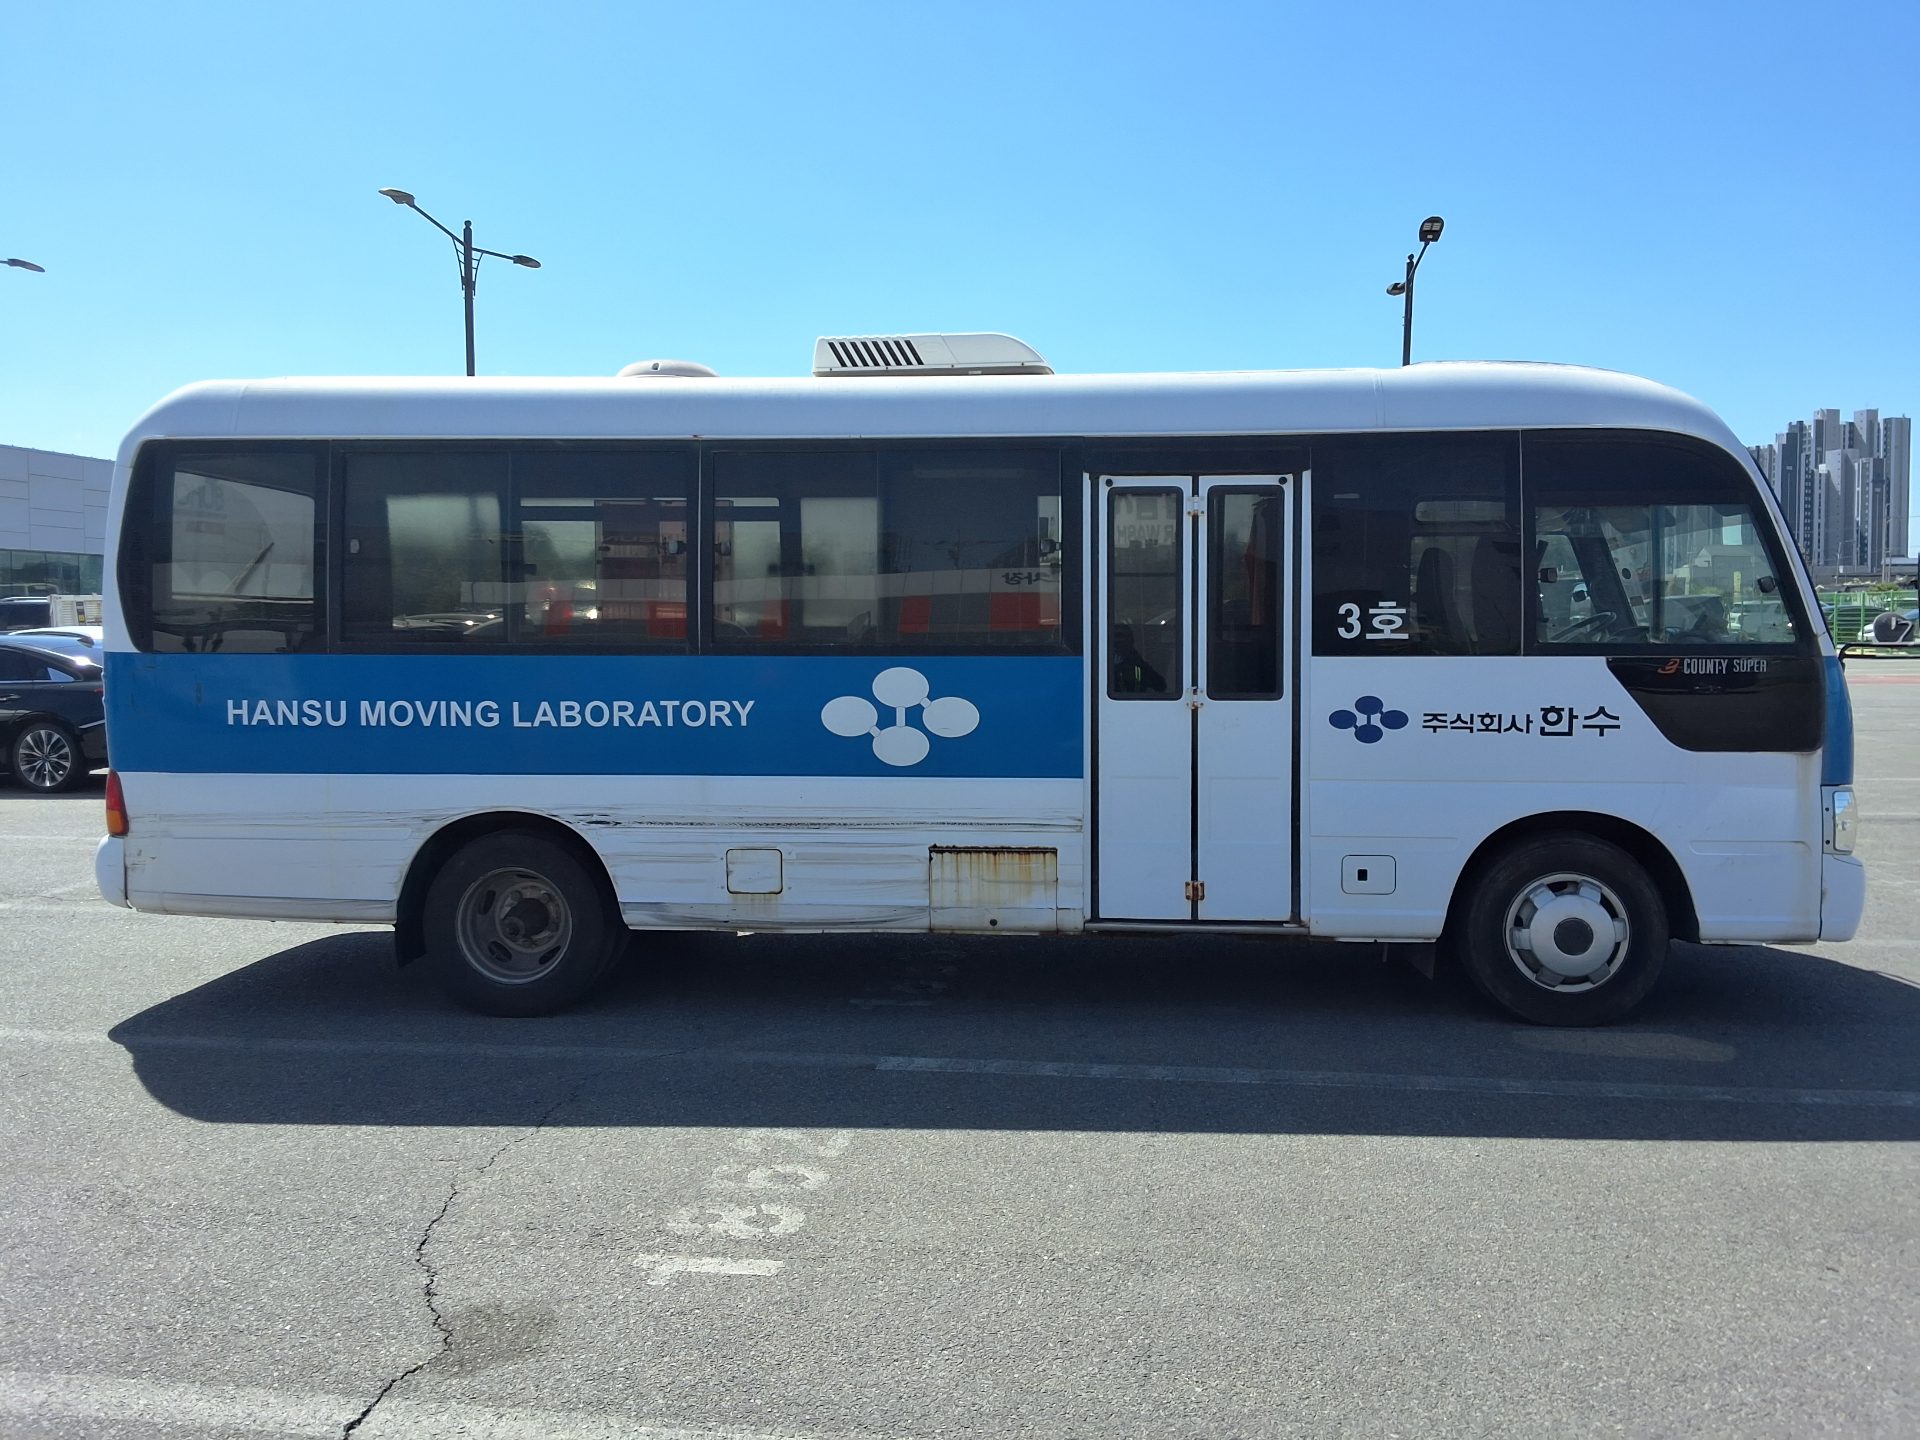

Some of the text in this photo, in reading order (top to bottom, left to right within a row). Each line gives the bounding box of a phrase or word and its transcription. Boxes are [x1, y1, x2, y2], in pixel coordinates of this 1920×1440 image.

[1337, 601, 1409, 640] 3호
[1683, 658, 1728, 675] COUNTY
[1733, 658, 1767, 673] SUPER
[226, 699, 755, 729] HANSU MOVING LABORATORY
